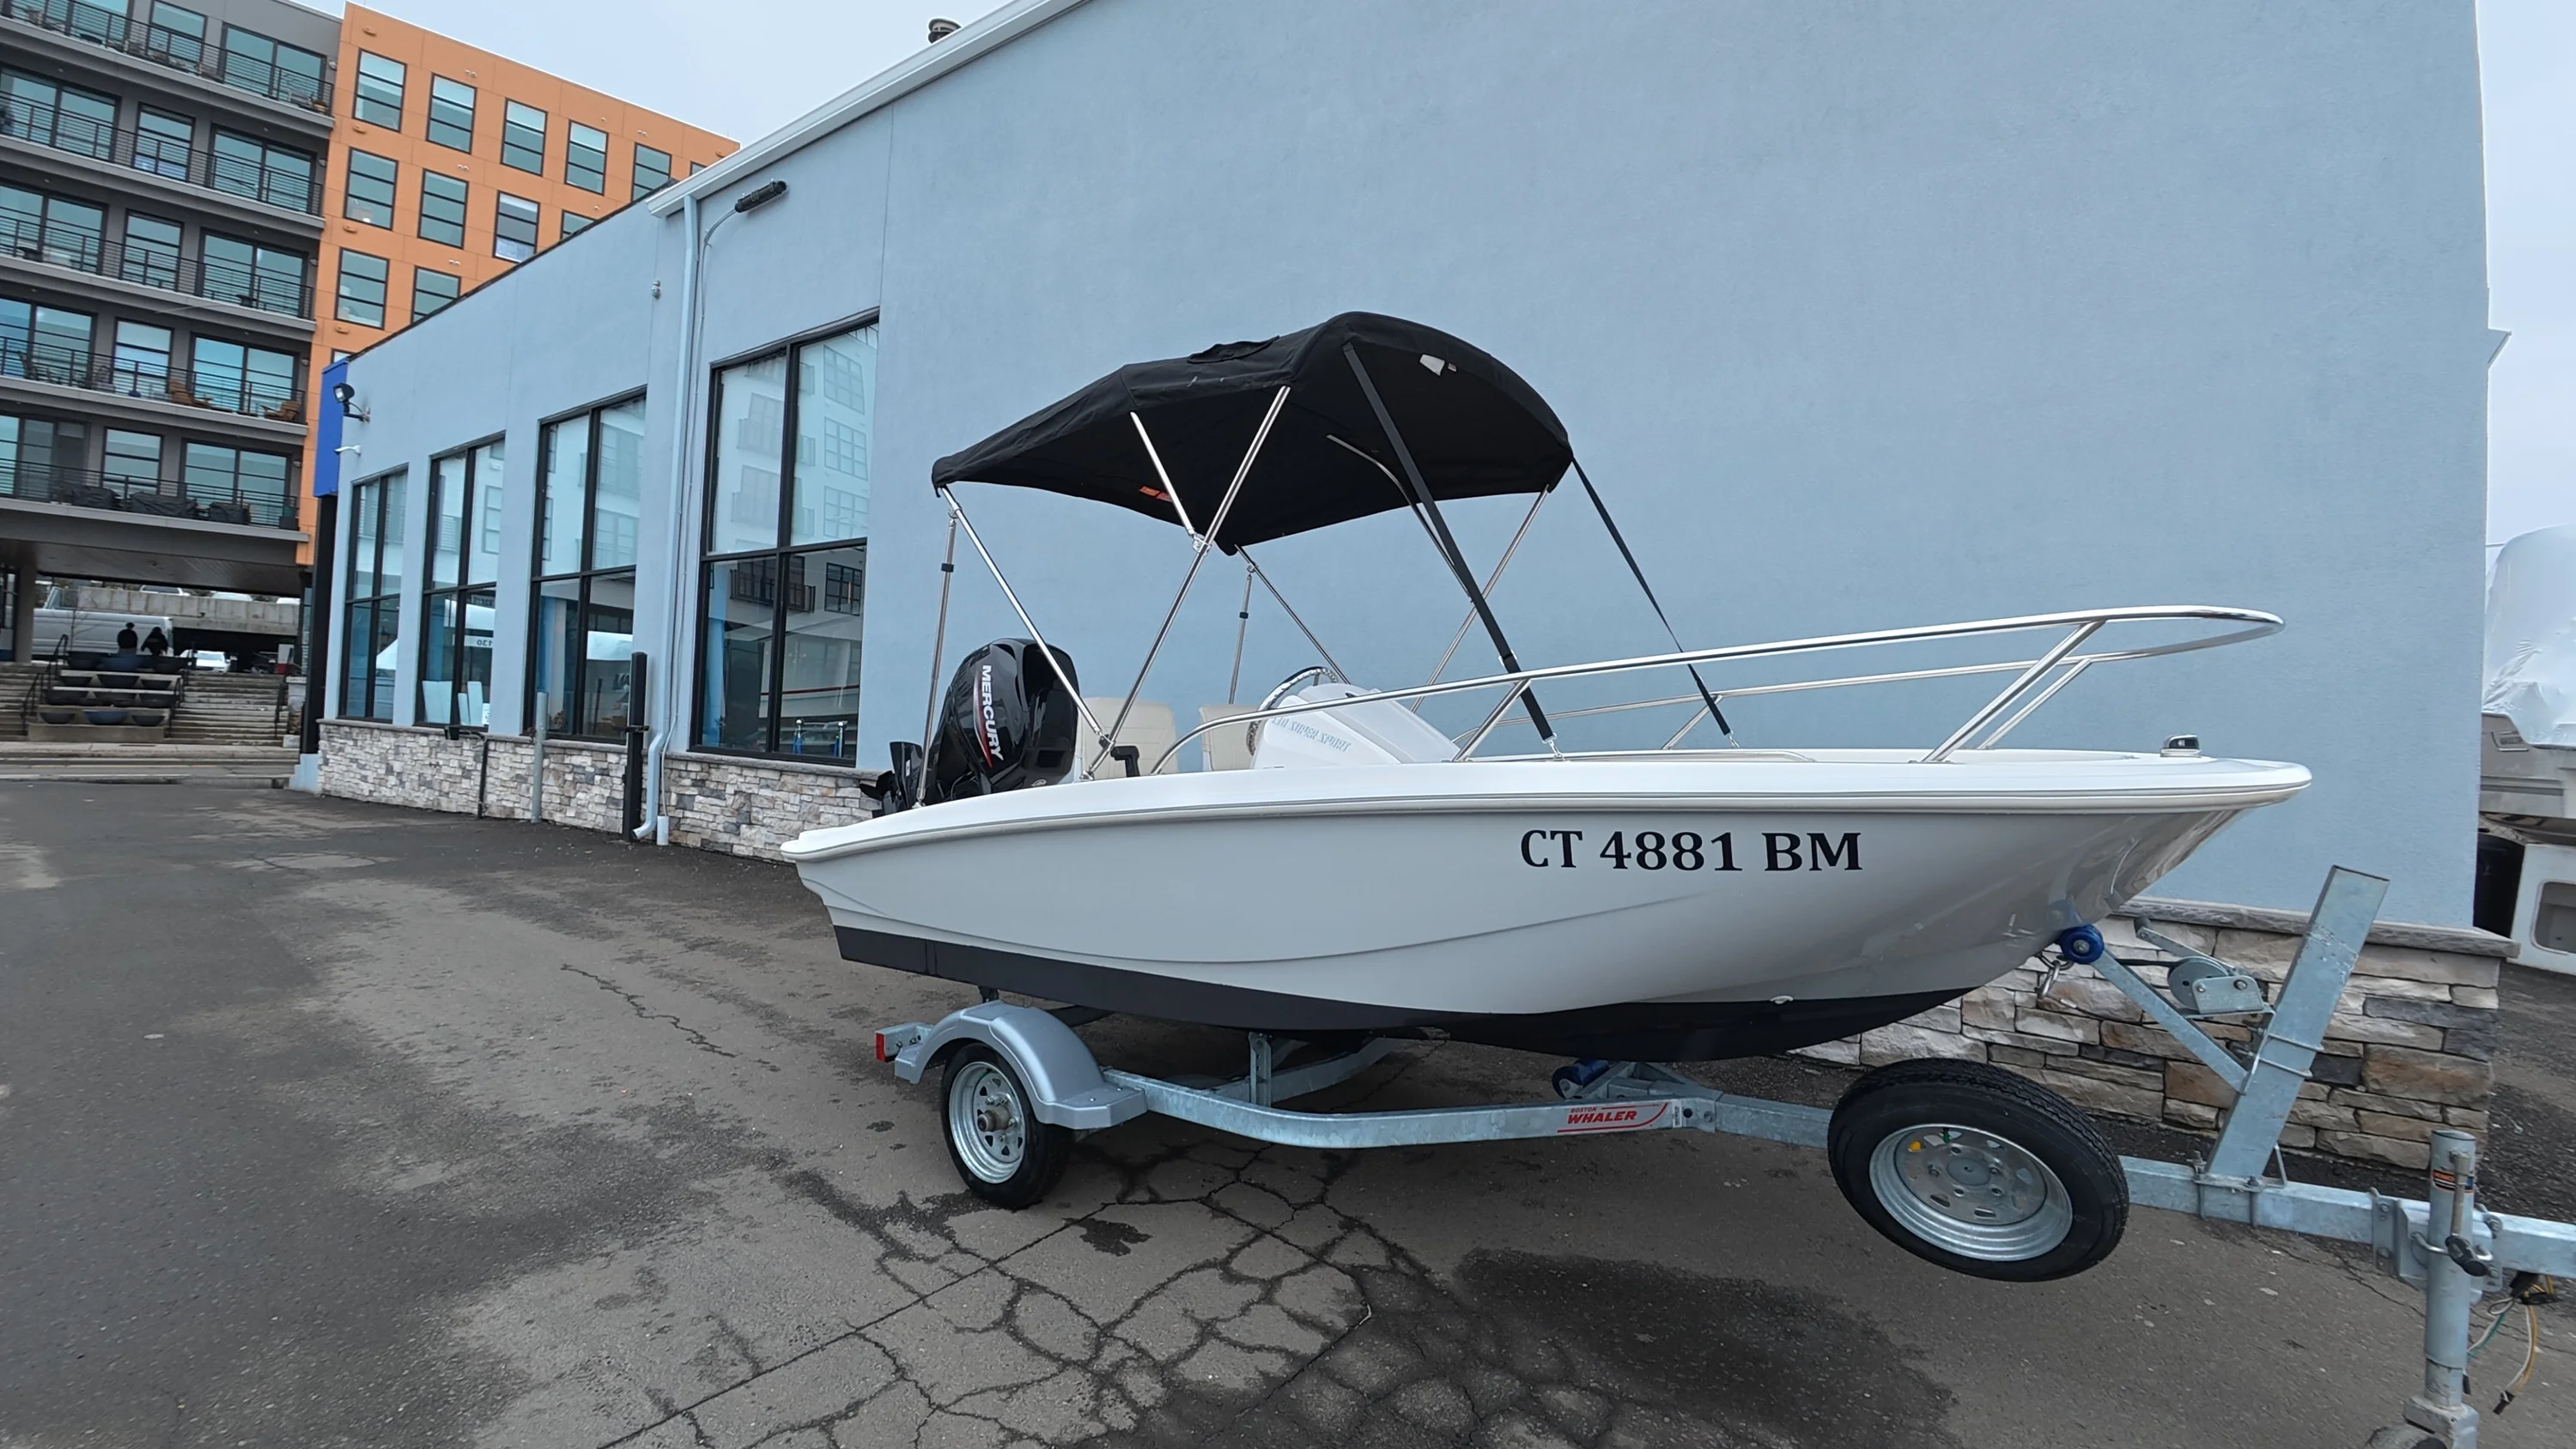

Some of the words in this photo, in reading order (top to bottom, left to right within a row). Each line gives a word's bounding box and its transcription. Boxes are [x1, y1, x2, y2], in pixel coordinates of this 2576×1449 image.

[981, 664, 1005, 761] MERCURY
[1288, 720, 1320, 740] SUPER
[1521, 829, 1583, 868] CT
[1600, 831, 1743, 871] 4881
[1761, 832, 1863, 871] BM
[1567, 1110, 1637, 1125] WHALER
